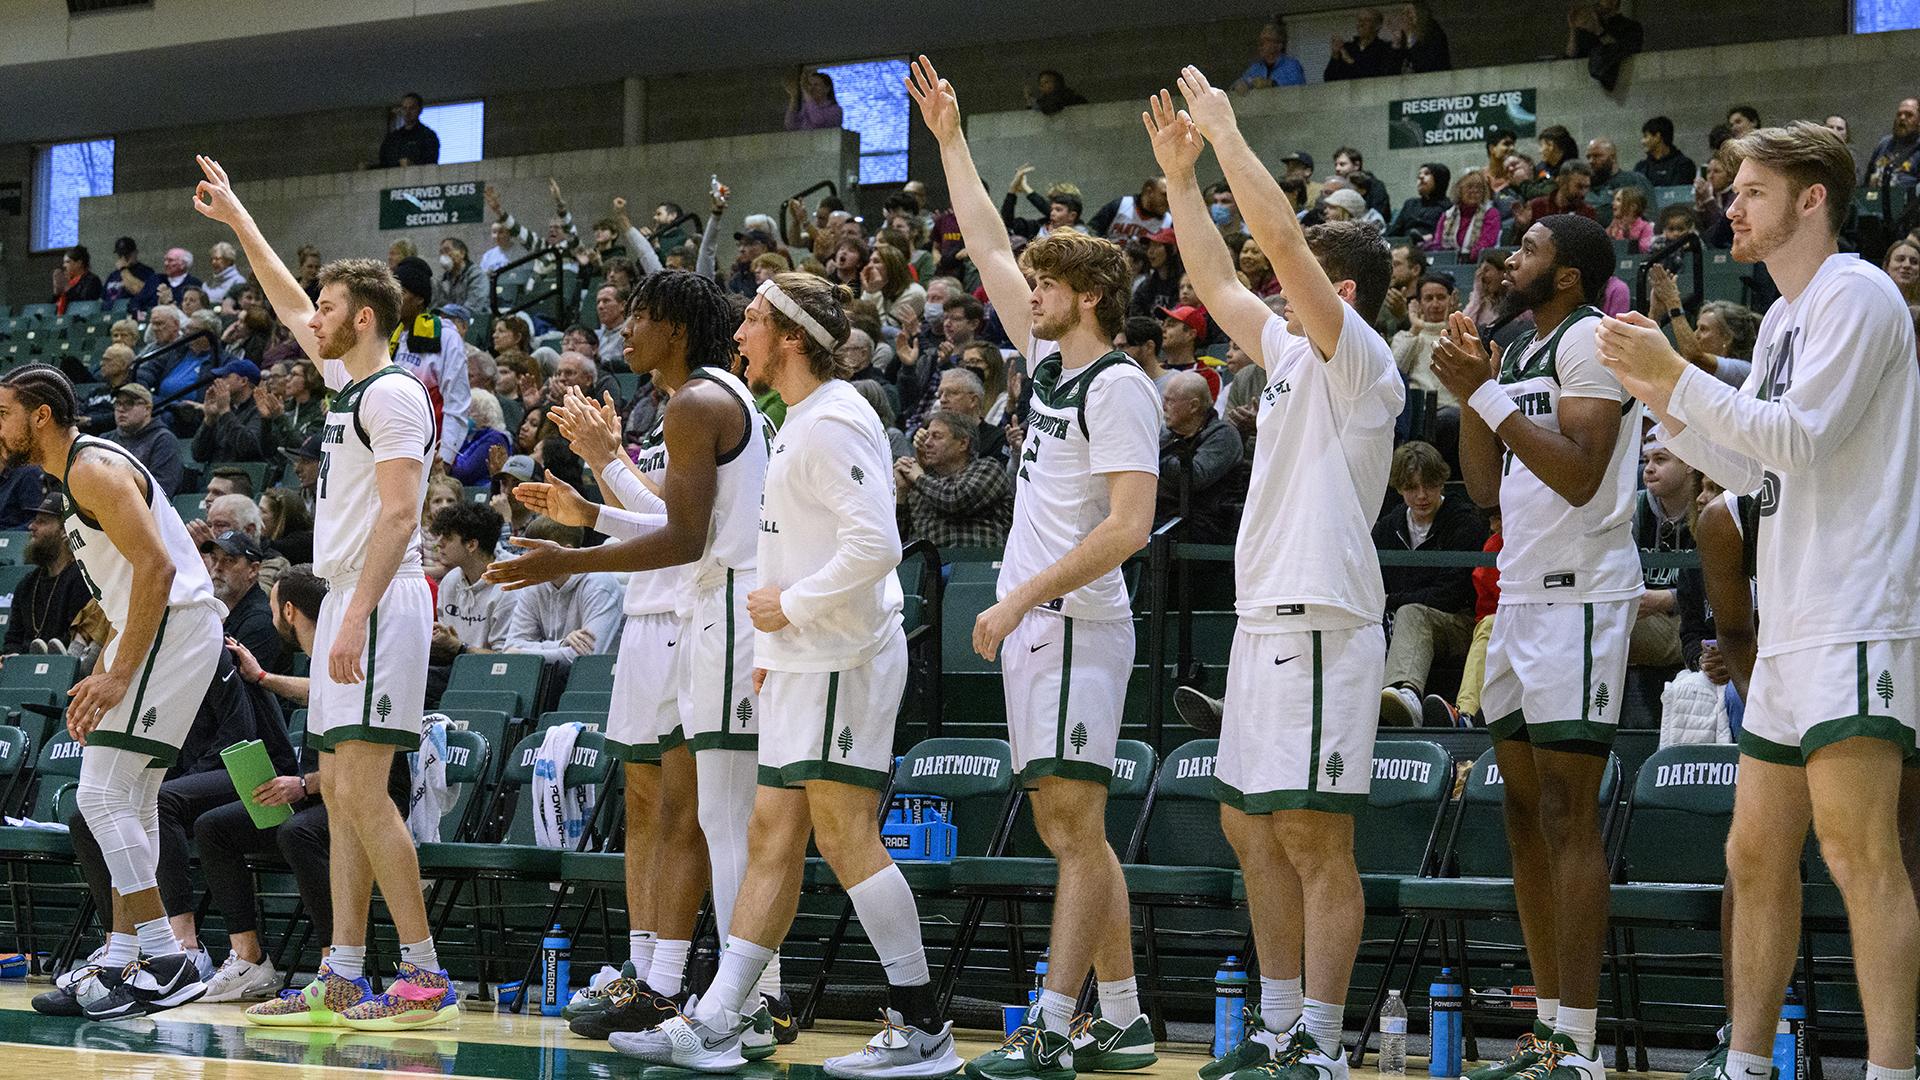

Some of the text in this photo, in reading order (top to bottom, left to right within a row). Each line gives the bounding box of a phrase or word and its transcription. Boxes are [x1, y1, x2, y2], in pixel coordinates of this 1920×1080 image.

[1402, 92, 1522, 114] RESERVED SEATS
[1444, 111, 1478, 126] ONLY
[1425, 127, 1484, 143] SECTION
[391, 183, 476, 200] RESERVED SEATS
[420, 200, 445, 211] ONLY
[406, 211, 458, 226] SECTION 2
[911, 755, 1000, 778] DARTMOUTH
[1655, 762, 1739, 787] DARTMO
[881, 836, 909, 848] RADE
[547, 949, 556, 1003] POWERADE
